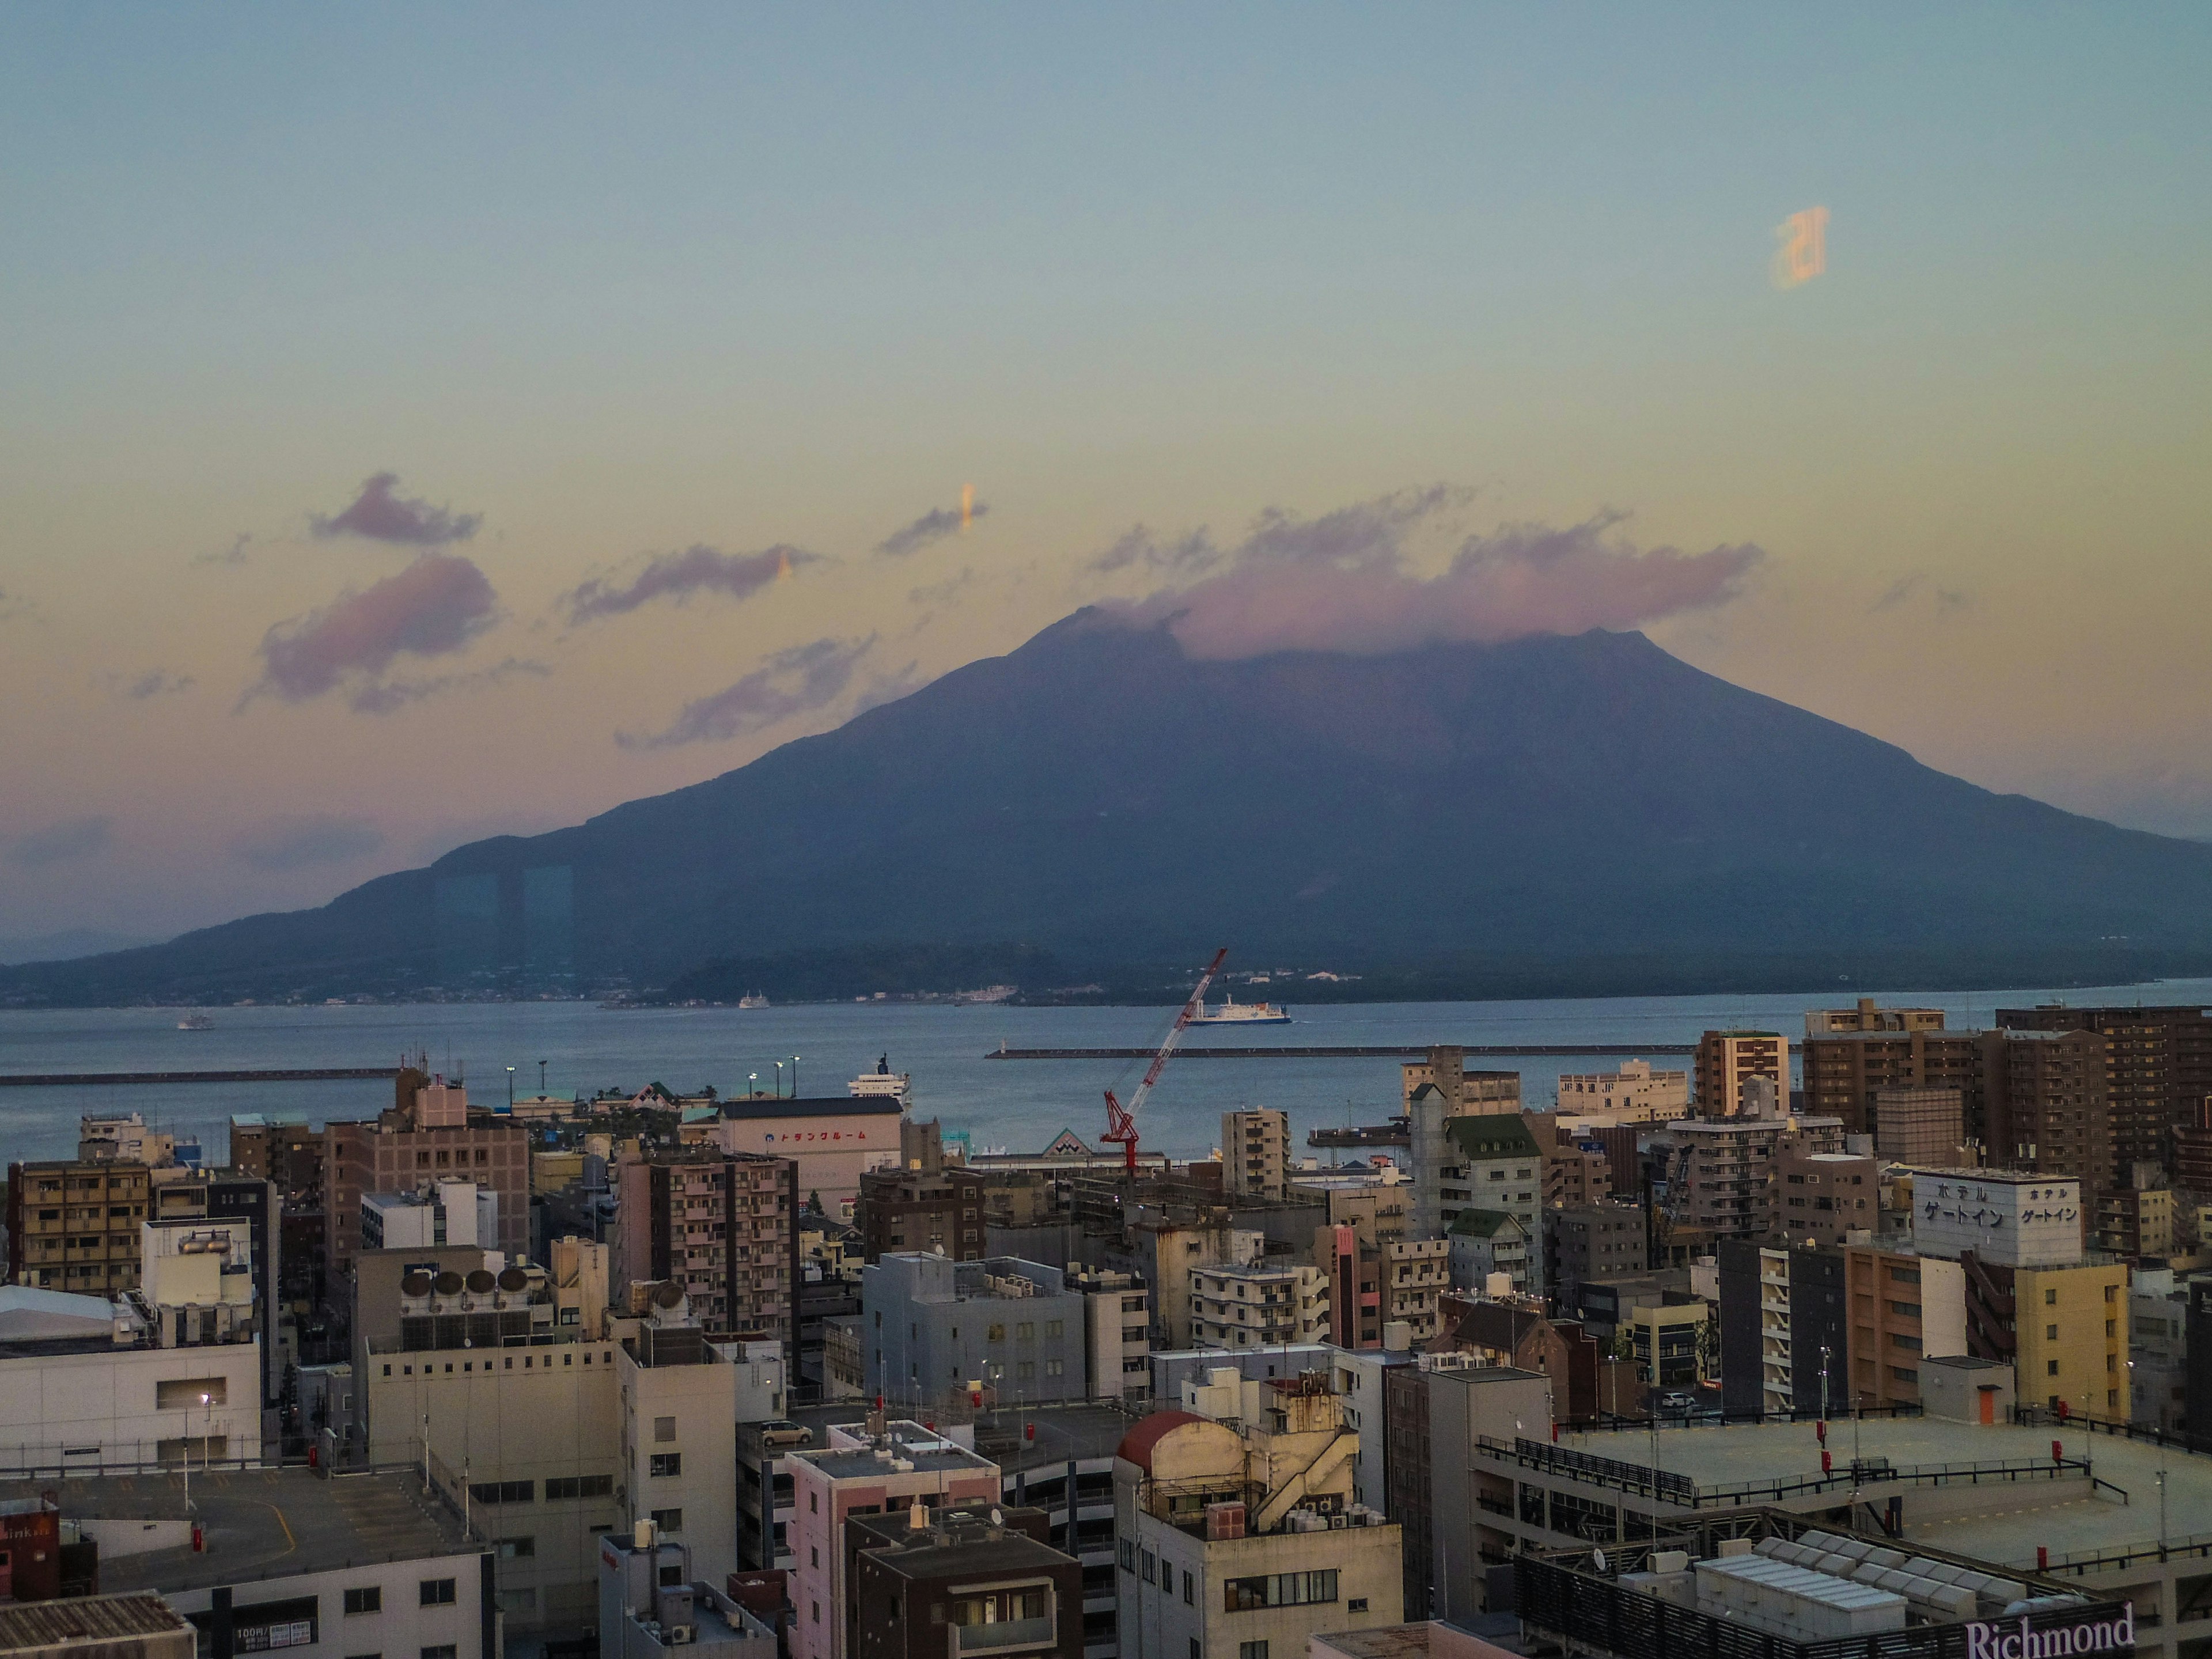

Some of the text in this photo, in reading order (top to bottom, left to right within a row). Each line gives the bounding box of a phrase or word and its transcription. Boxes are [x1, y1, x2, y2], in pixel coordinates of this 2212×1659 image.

[782, 1131, 866, 1141] トランクルーム
[1938, 1183, 1987, 1202] ホテル
[2031, 1188, 2067, 1200] ホテル
[1925, 1200, 2003, 1228] ゲートイン
[2021, 1207, 2077, 1223] ゲートイン
[1965, 1601, 2135, 1659] Richmond
